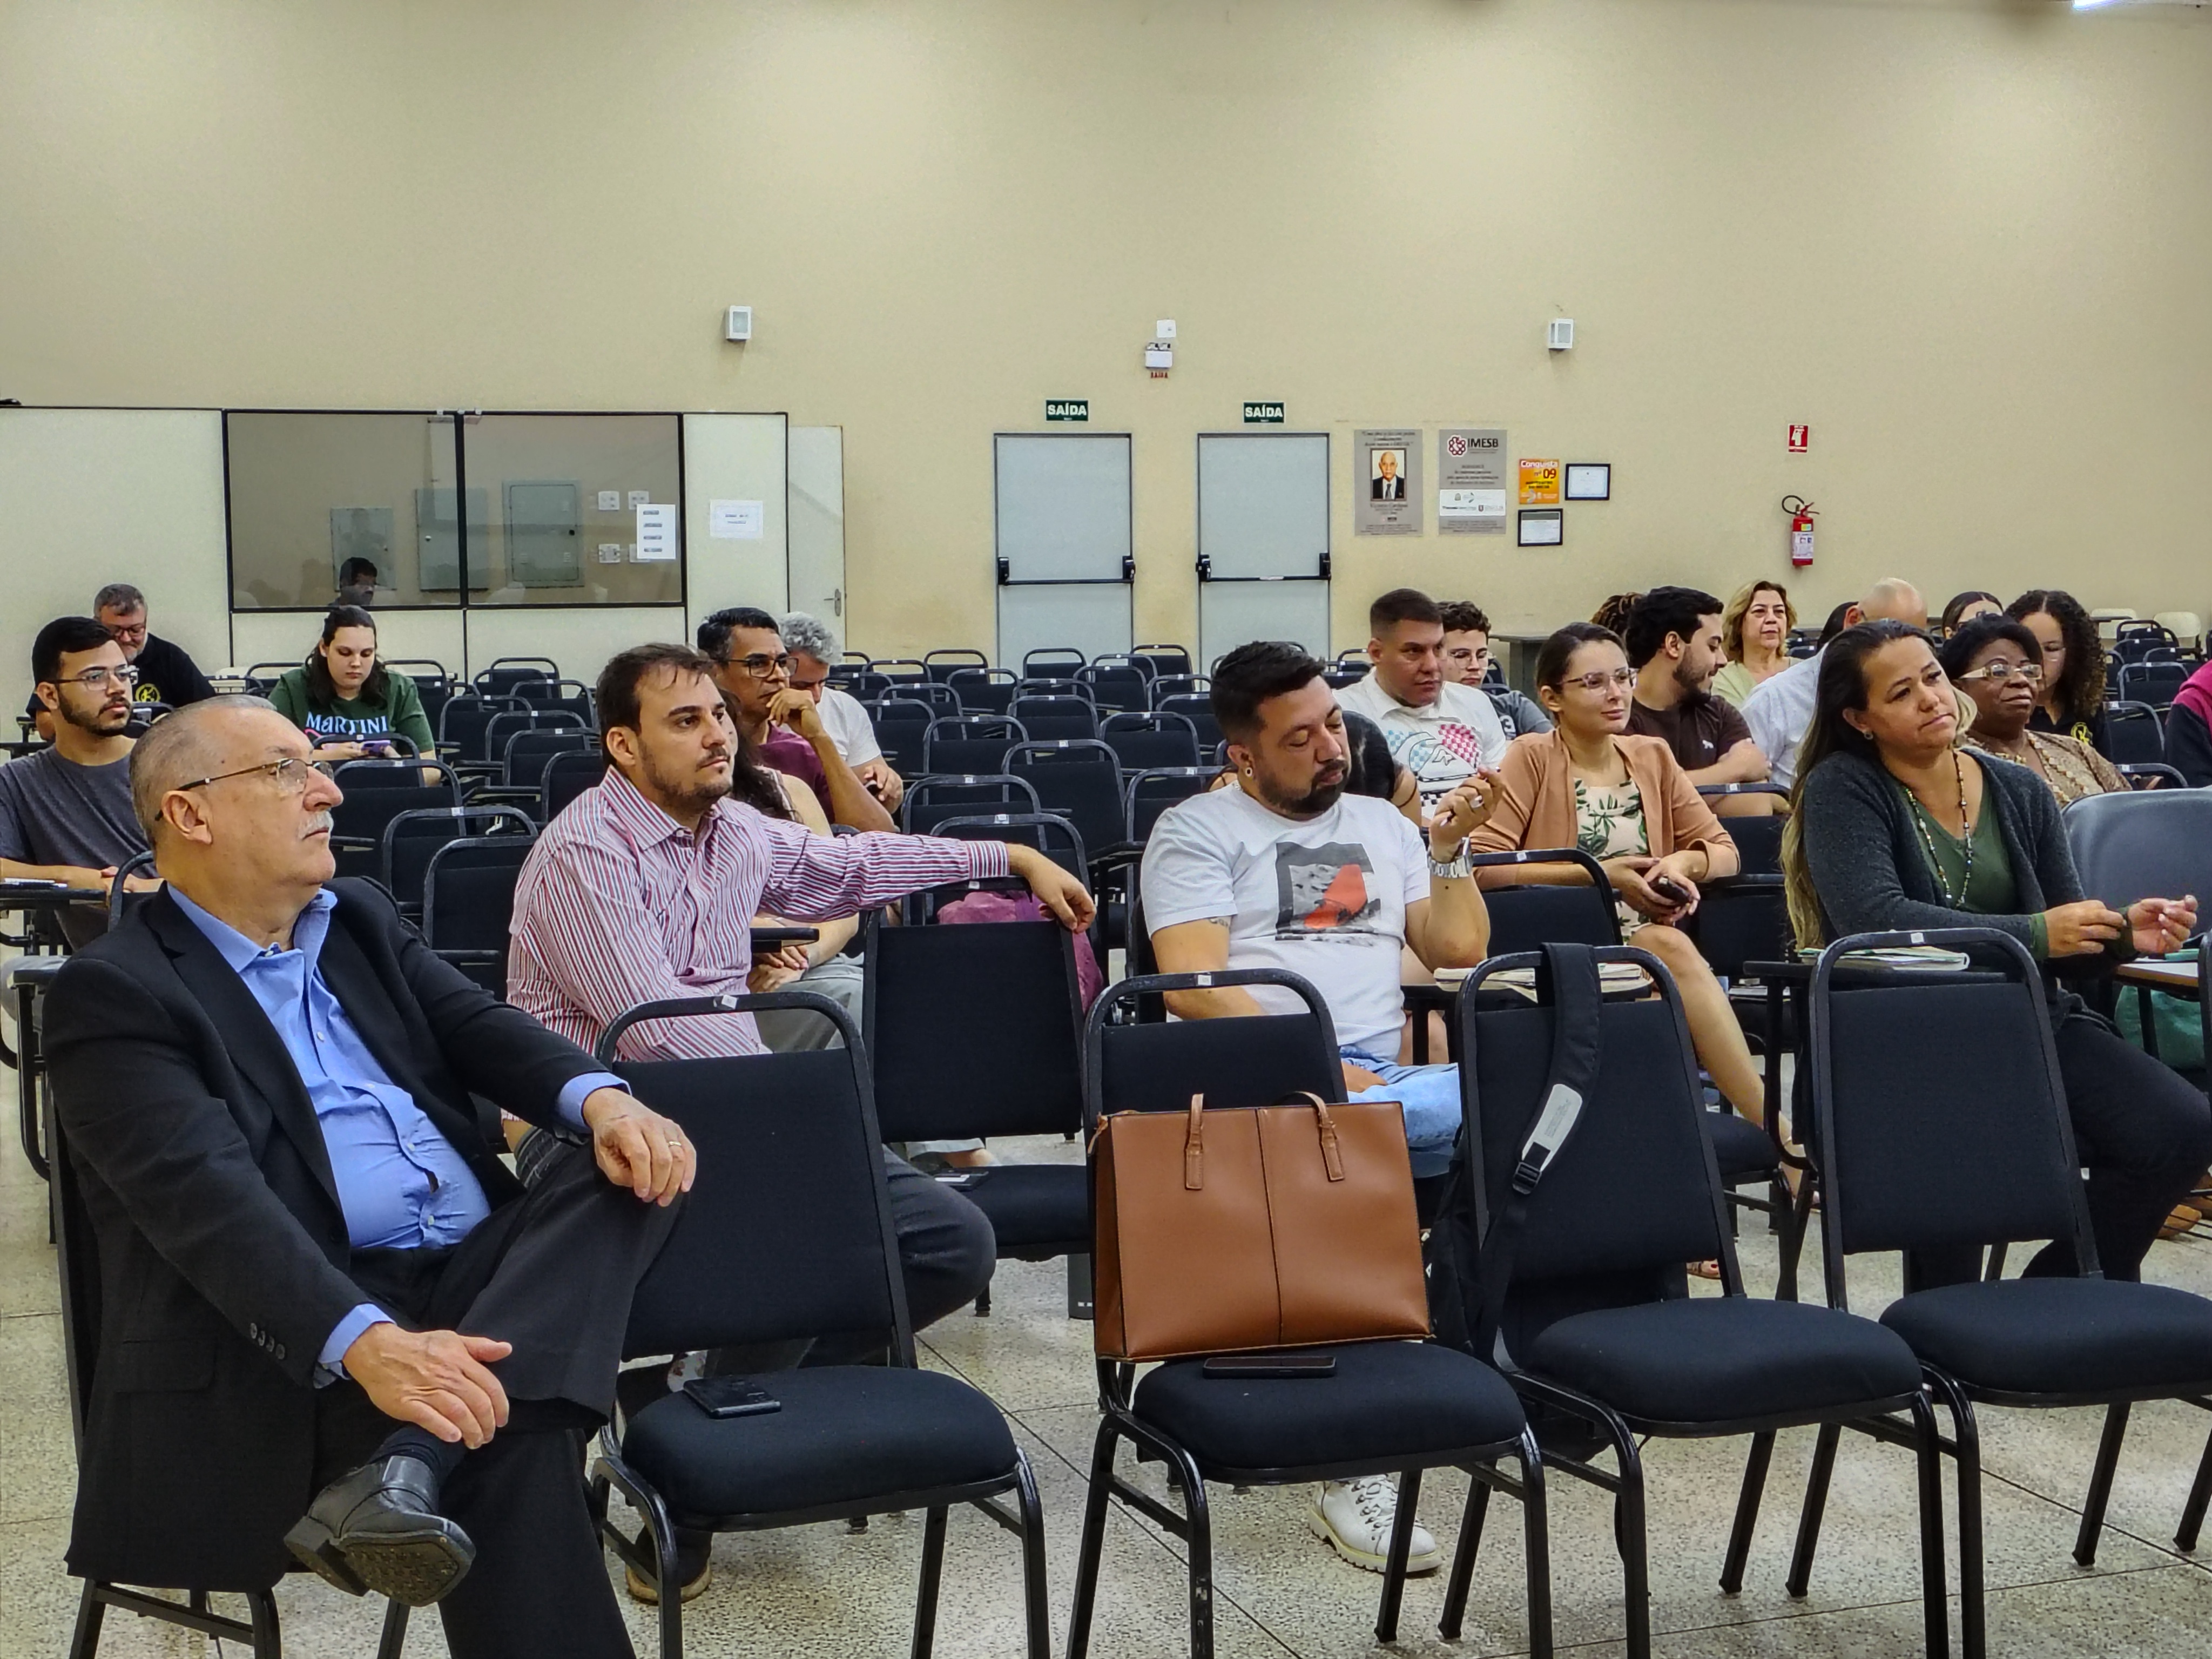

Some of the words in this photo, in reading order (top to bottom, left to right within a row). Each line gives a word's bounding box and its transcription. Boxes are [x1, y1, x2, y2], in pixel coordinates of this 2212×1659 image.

[1048, 402, 1087, 415] SAÍDA
[1245, 404, 1283, 417] SAÍDA
[1467, 438, 1499, 448] IMESB
[1521, 460, 1557, 469] Conquista
[1543, 468, 1556, 479] 09
